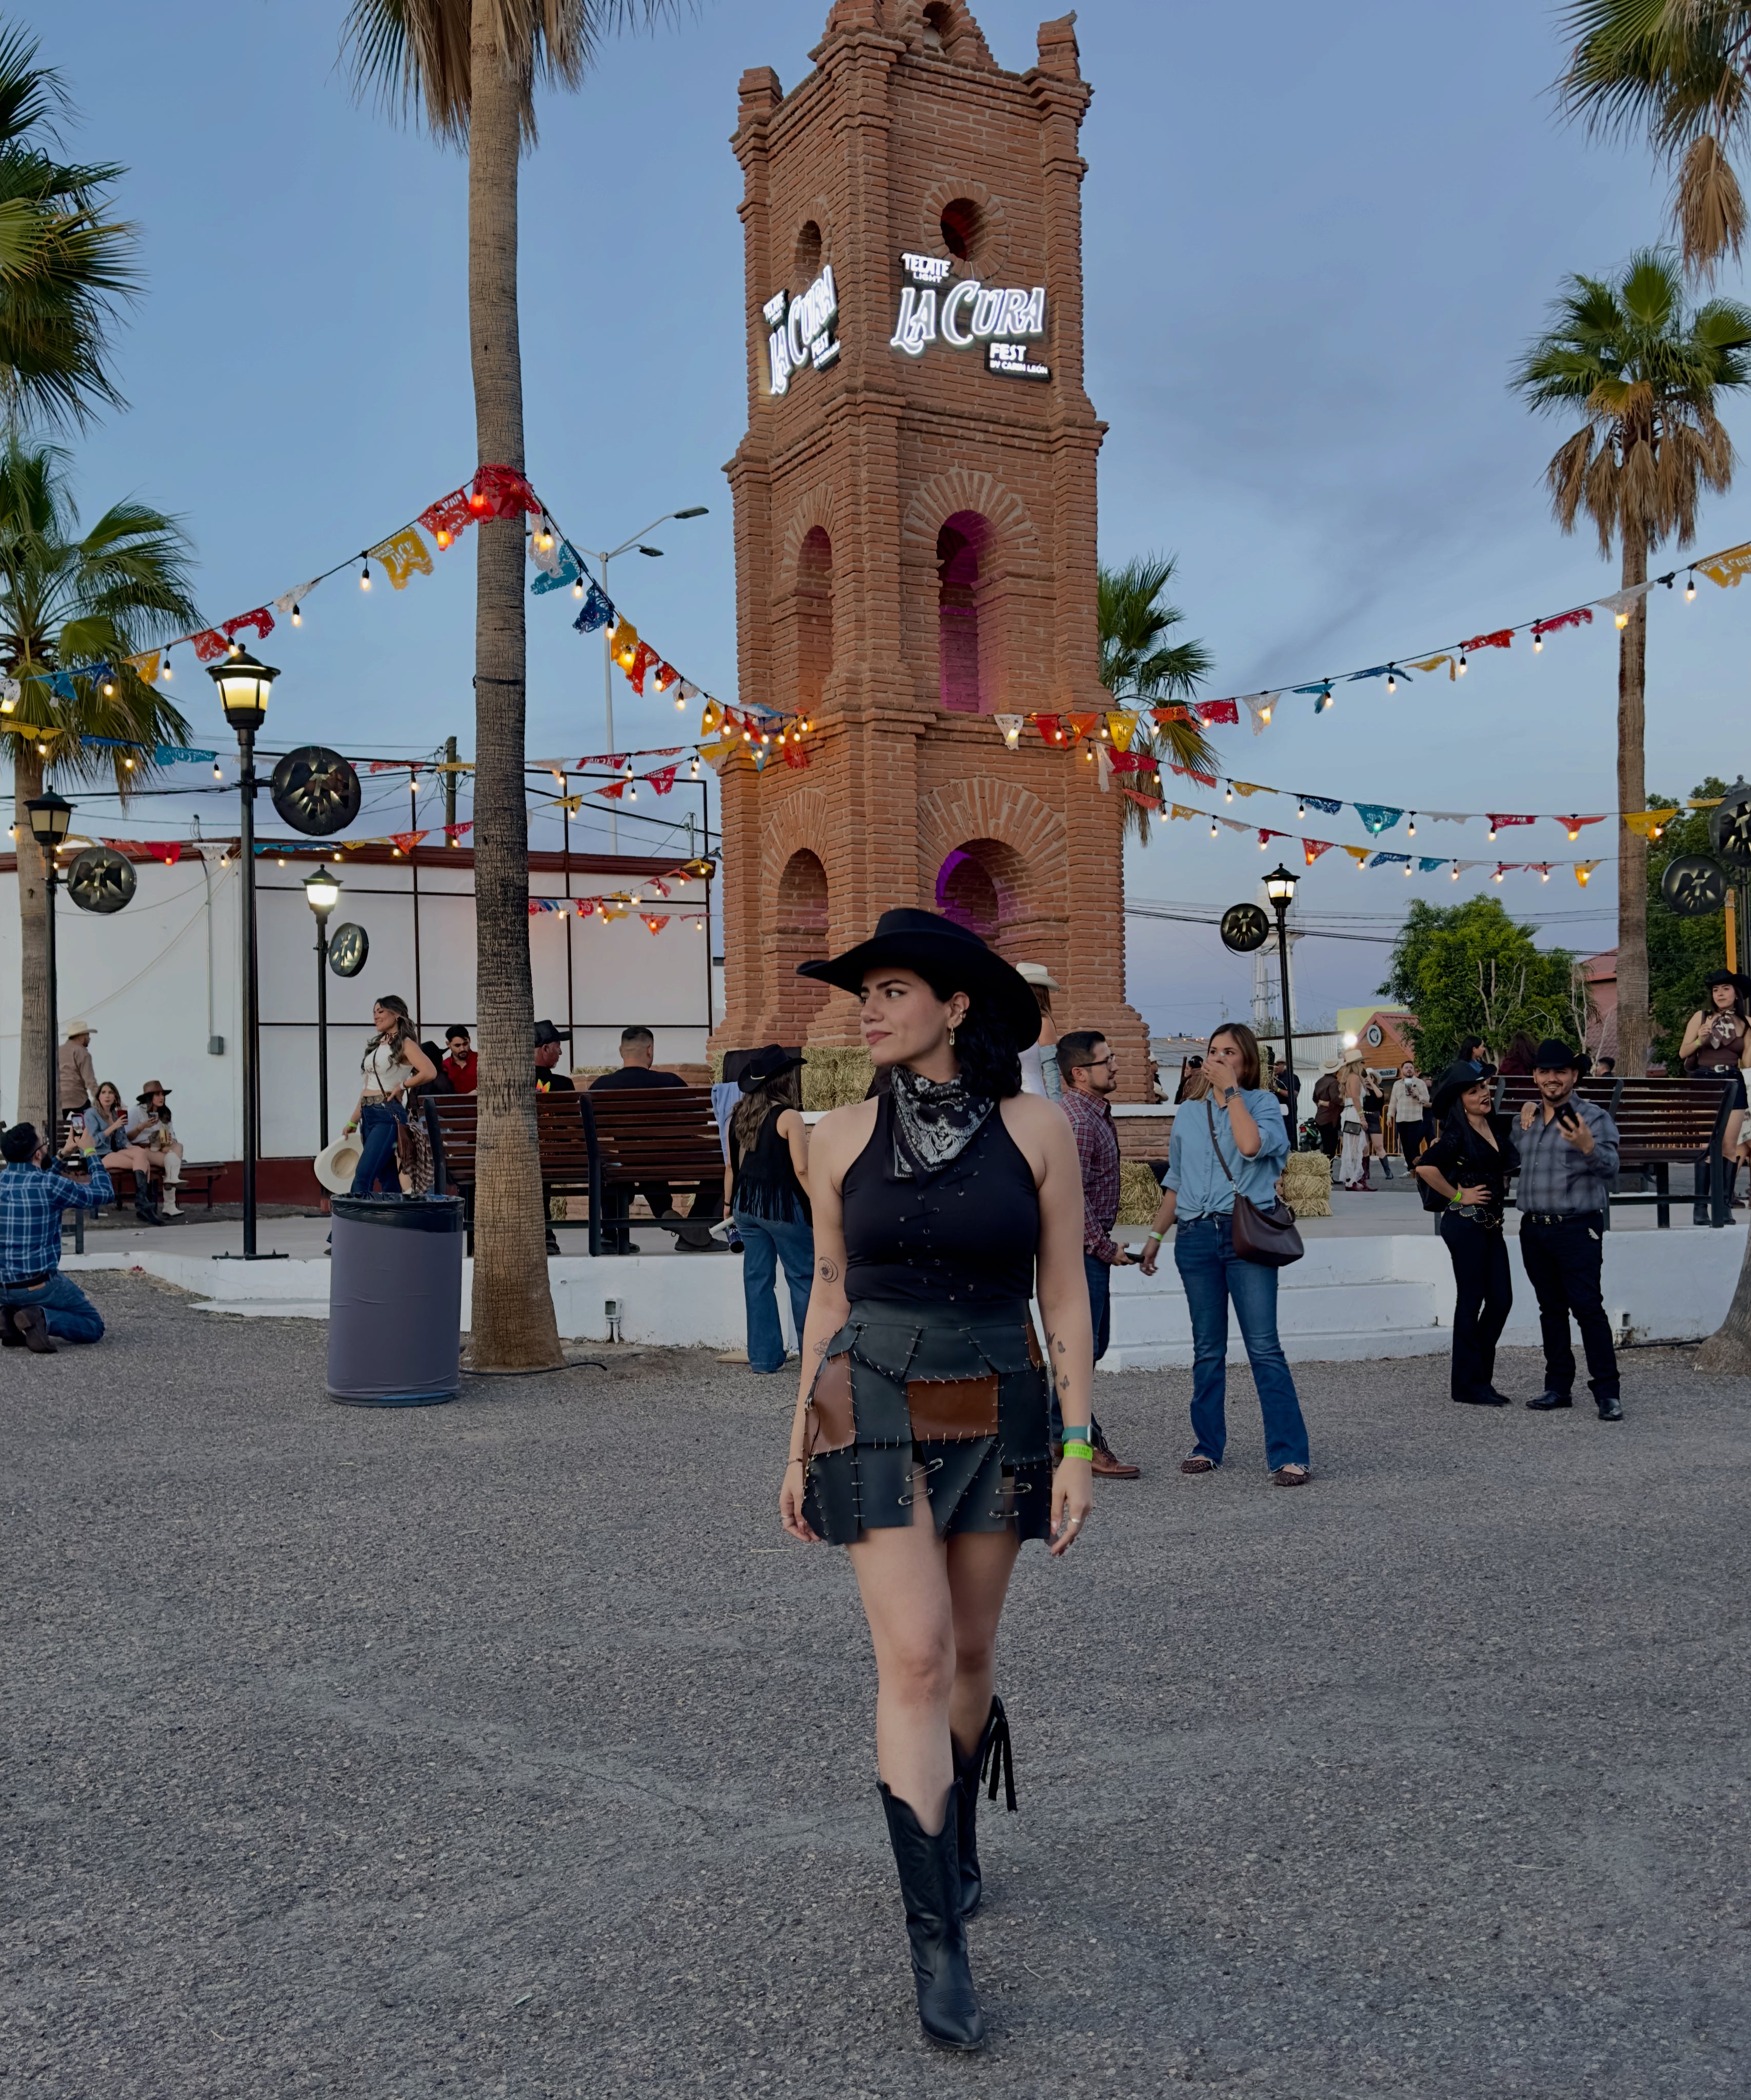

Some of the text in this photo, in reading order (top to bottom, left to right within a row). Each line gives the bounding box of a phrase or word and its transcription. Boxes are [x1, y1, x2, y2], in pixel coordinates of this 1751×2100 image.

[901, 253, 951, 277] TECATE
[913, 272, 943, 283] LIGHT
[890, 287, 936, 355] LA
[942, 280, 1045, 345] CURA
[990, 343, 1027, 362] FEST
